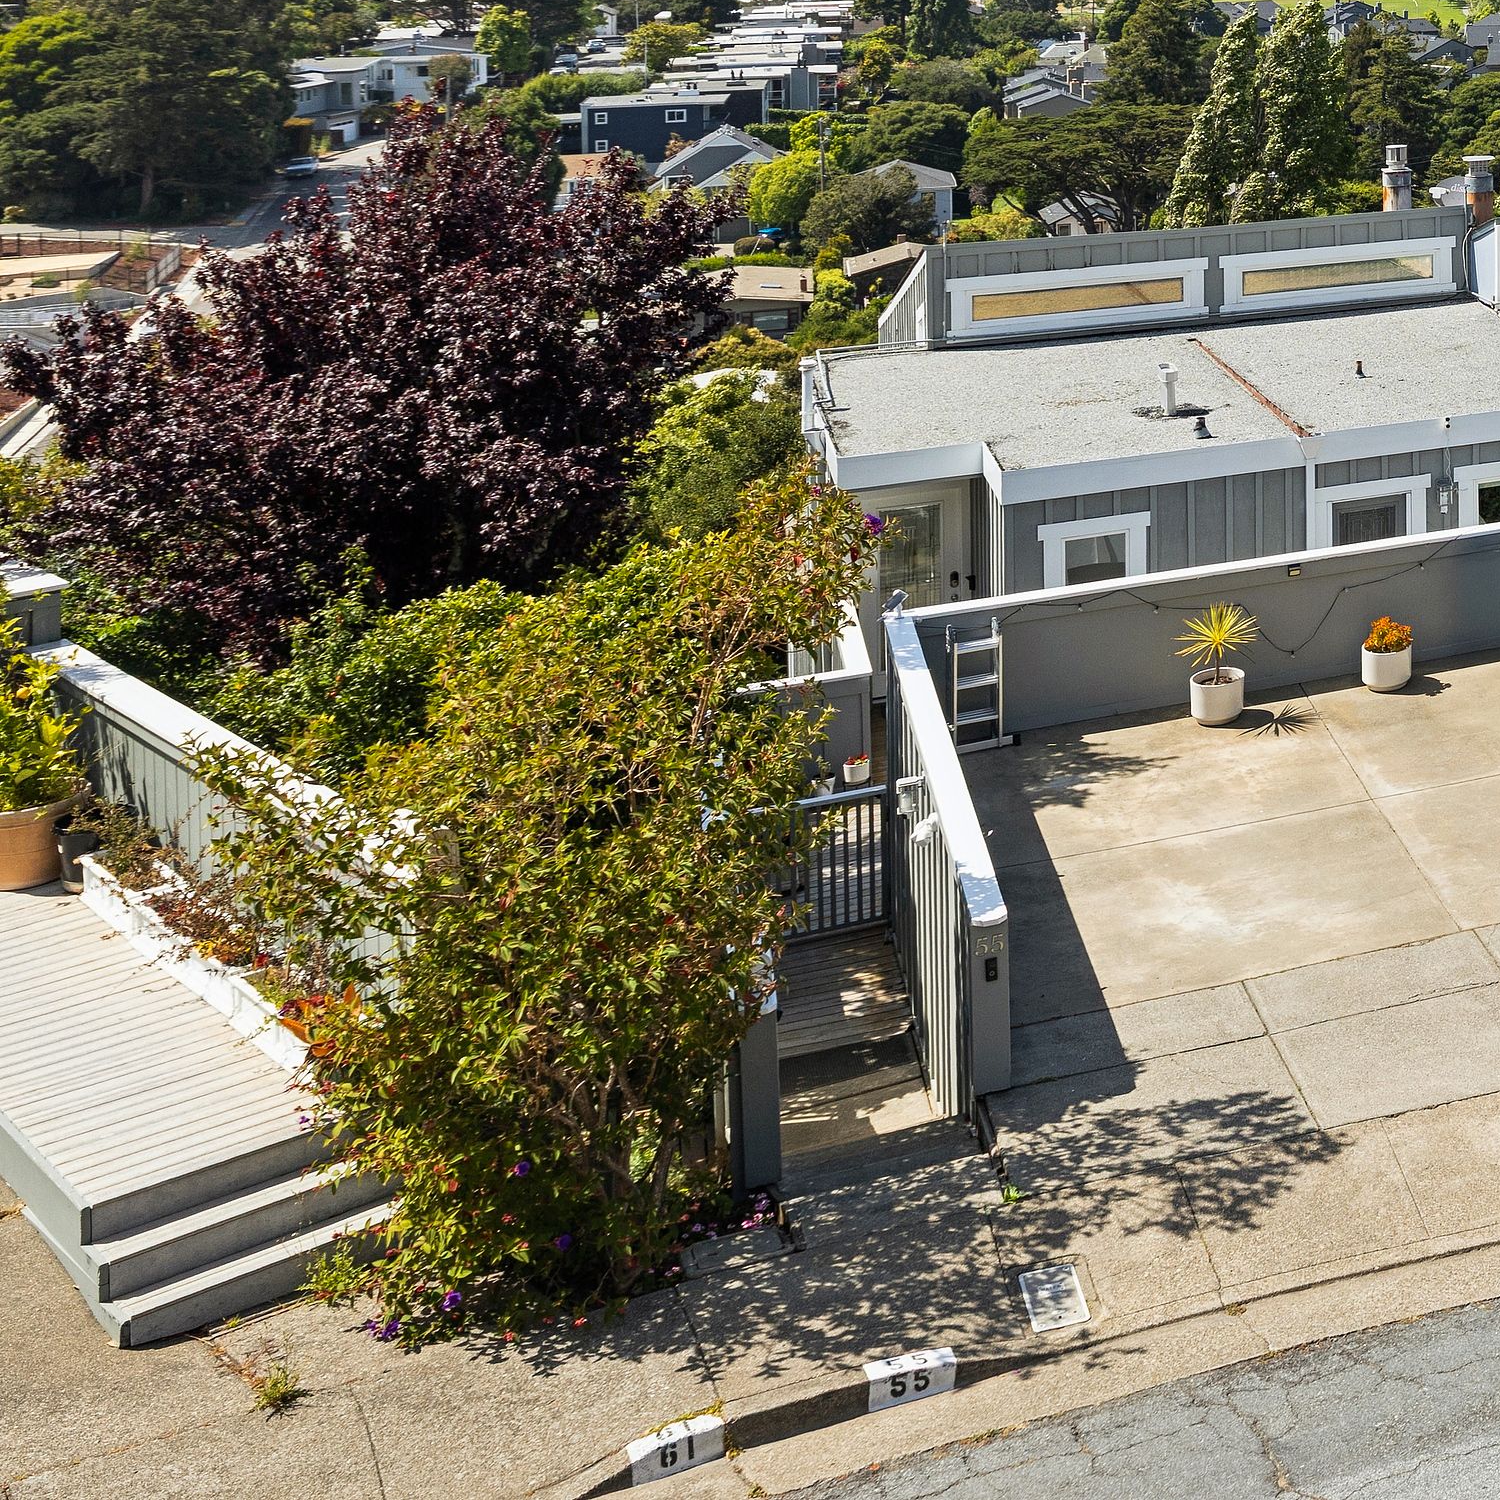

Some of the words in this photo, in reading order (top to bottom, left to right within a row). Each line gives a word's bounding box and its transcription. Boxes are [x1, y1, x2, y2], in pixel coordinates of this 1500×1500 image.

[975, 932, 1004, 957] 55
[885, 1352, 928, 1370] 55
[888, 1368, 931, 1398] 55
[660, 1434, 695, 1468] 61
